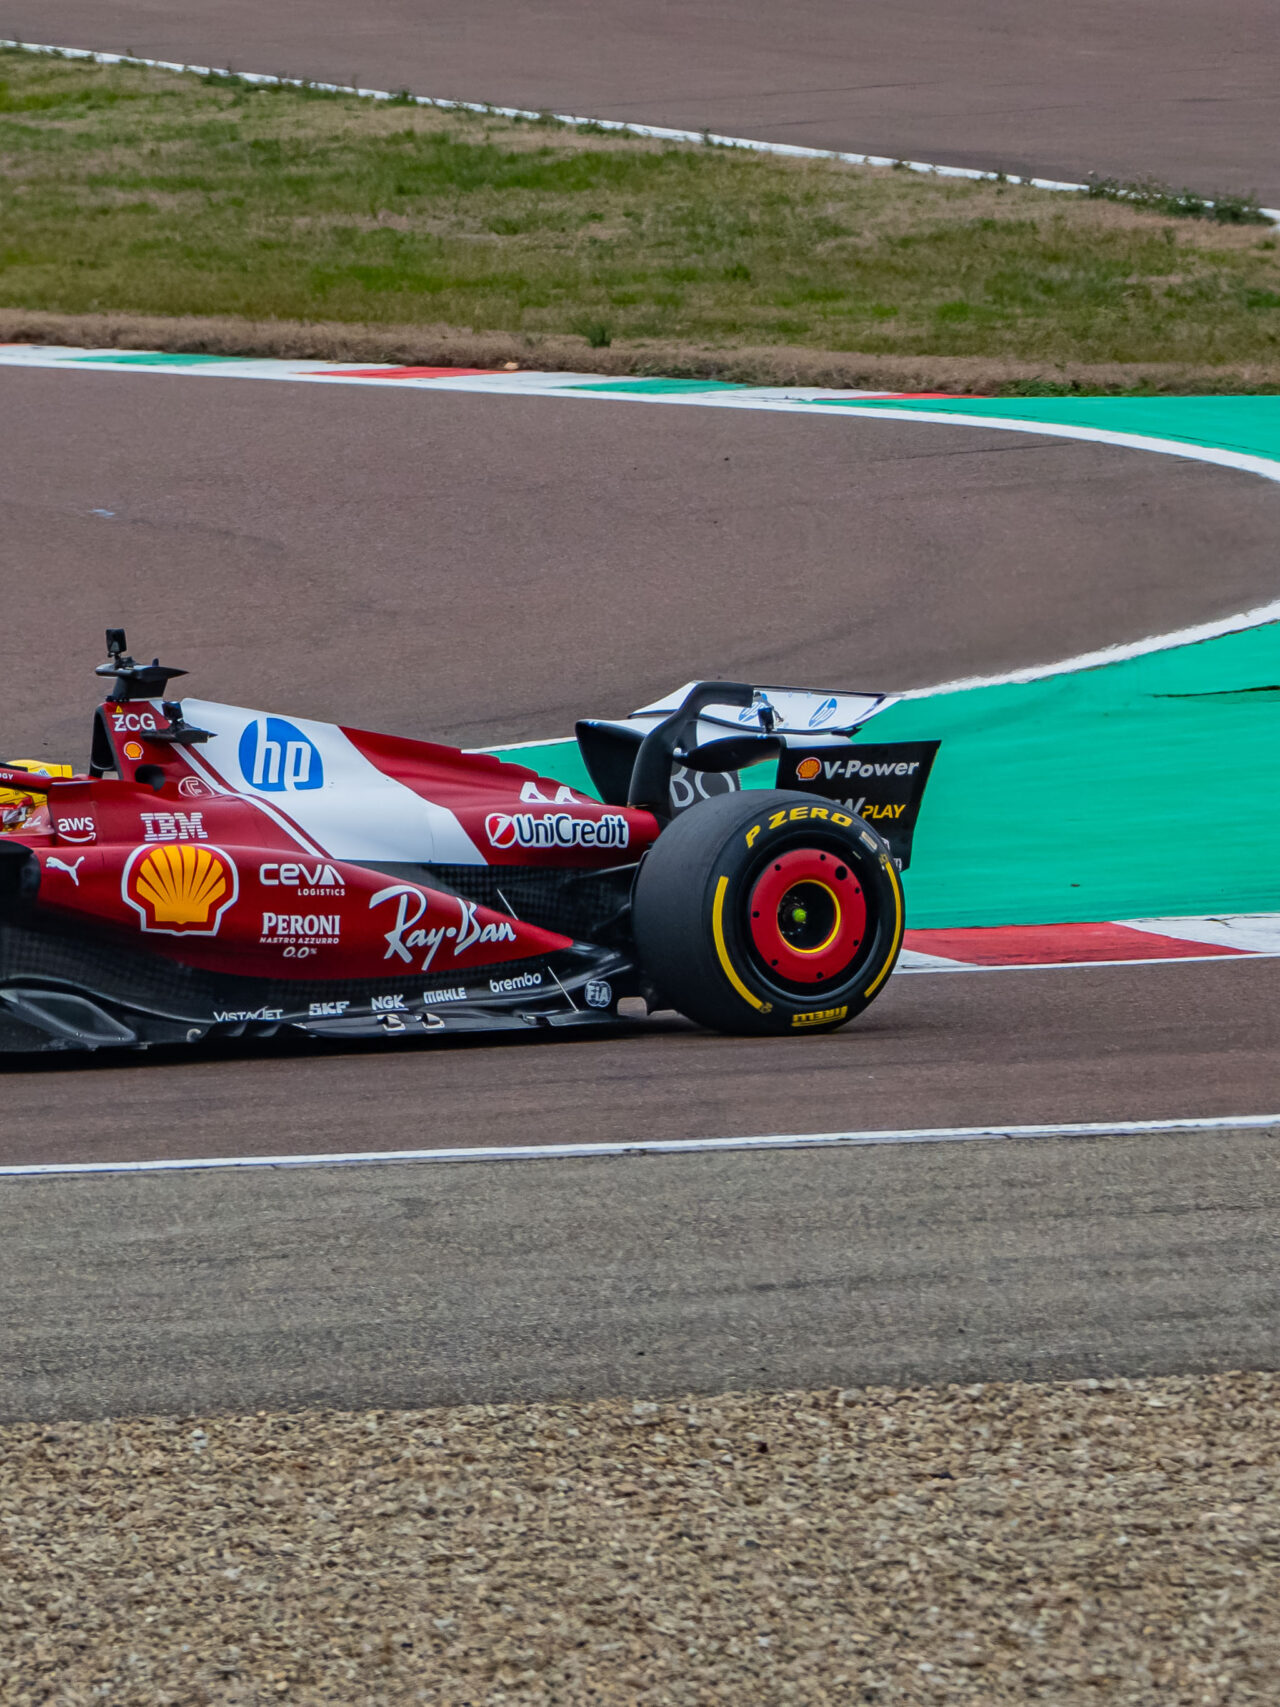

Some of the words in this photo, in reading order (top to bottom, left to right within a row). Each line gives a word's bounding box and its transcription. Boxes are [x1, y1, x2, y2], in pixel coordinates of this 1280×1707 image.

[250, 718, 313, 791] hp
[823, 760, 919, 779] V-Power
[861, 803, 907, 819] PLAY
[57, 816, 95, 833] aws
[140, 812, 209, 841] IBM
[515, 813, 628, 847] UniCredit
[745, 824, 761, 848] P
[768, 805, 854, 829] ZERO
[297, 888, 346, 897] LOGISTICS
[261, 911, 341, 936] PERONI
[259, 936, 297, 944] NASTRO
[297, 936, 340, 945] AZZURRO
[489, 971, 542, 994] brembo
[370, 993, 406, 1011] NGK
[423, 987, 468, 1004] MAHLE
[308, 1000, 350, 1016] SKF
